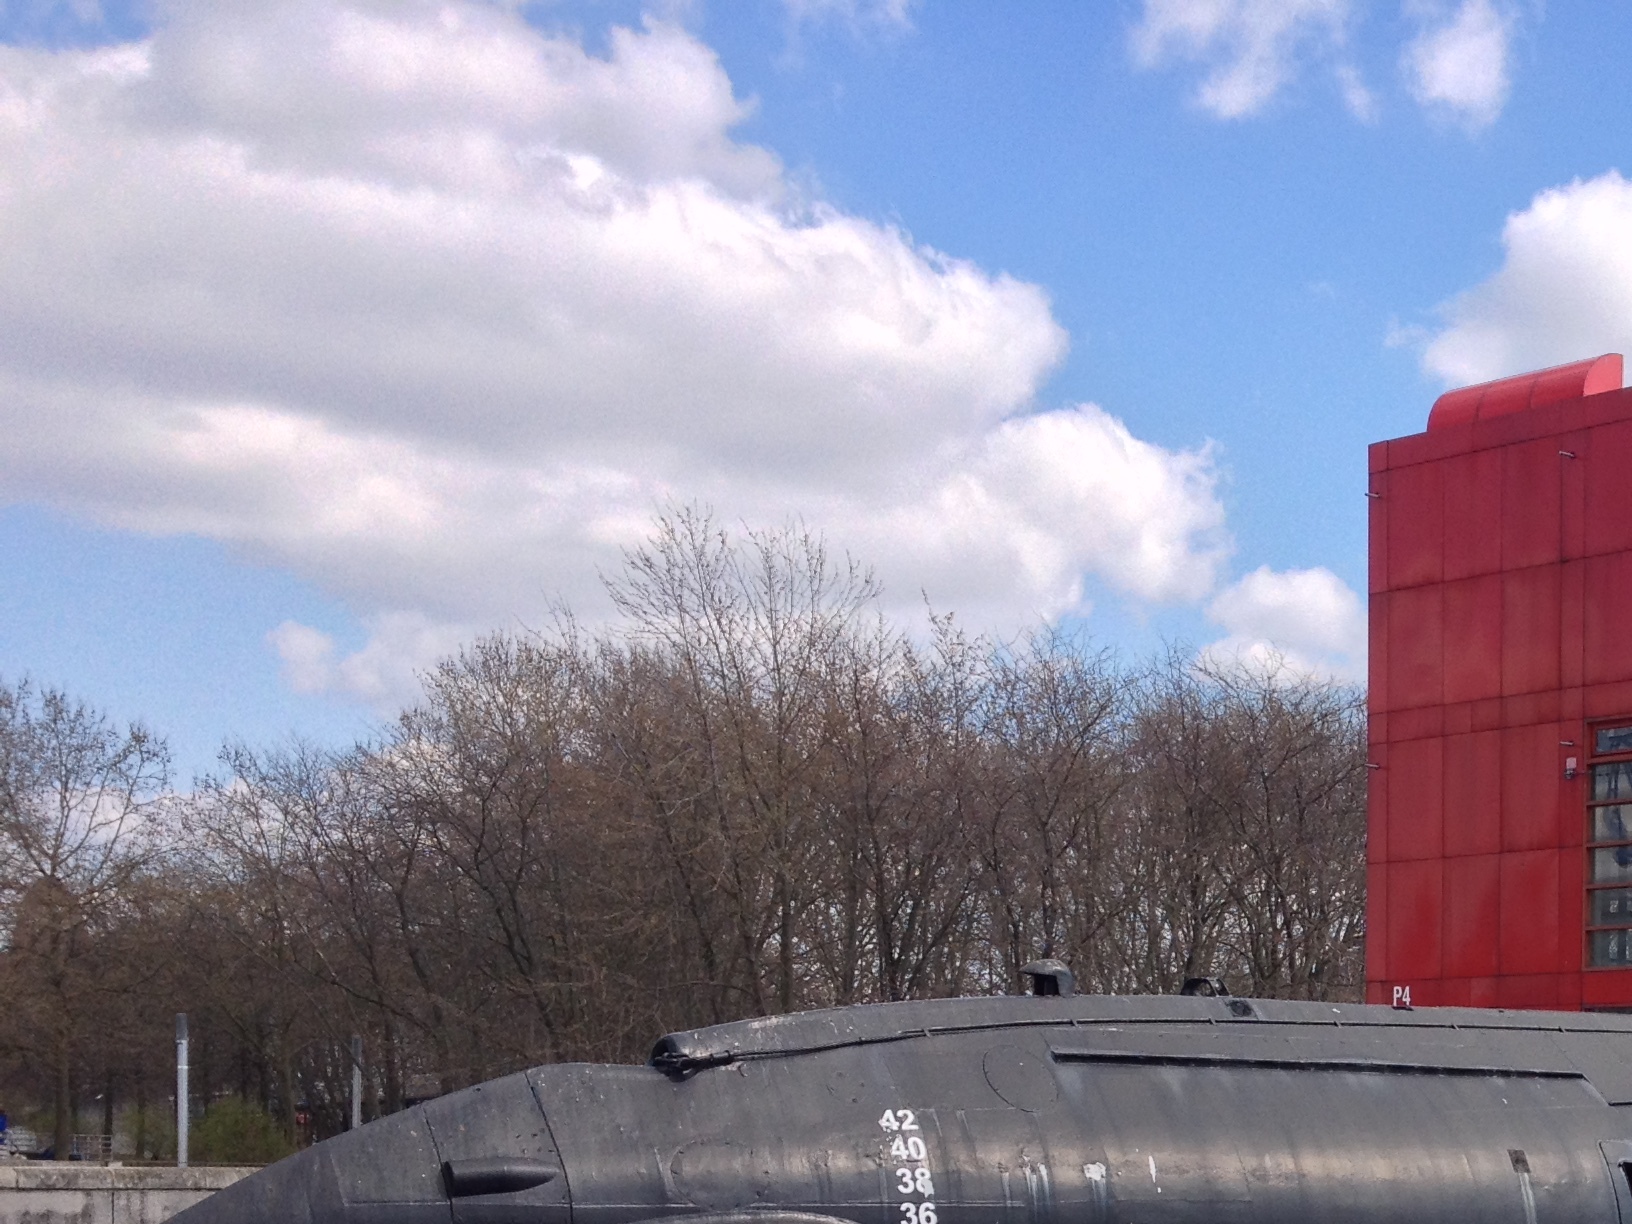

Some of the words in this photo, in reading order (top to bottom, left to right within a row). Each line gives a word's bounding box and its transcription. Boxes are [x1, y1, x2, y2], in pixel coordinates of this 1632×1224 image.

[1393, 986, 1411, 1007] P4
[878, 1109, 919, 1131] 42
[890, 1136, 926, 1160] 40
[896, 1168, 934, 1196] 38
